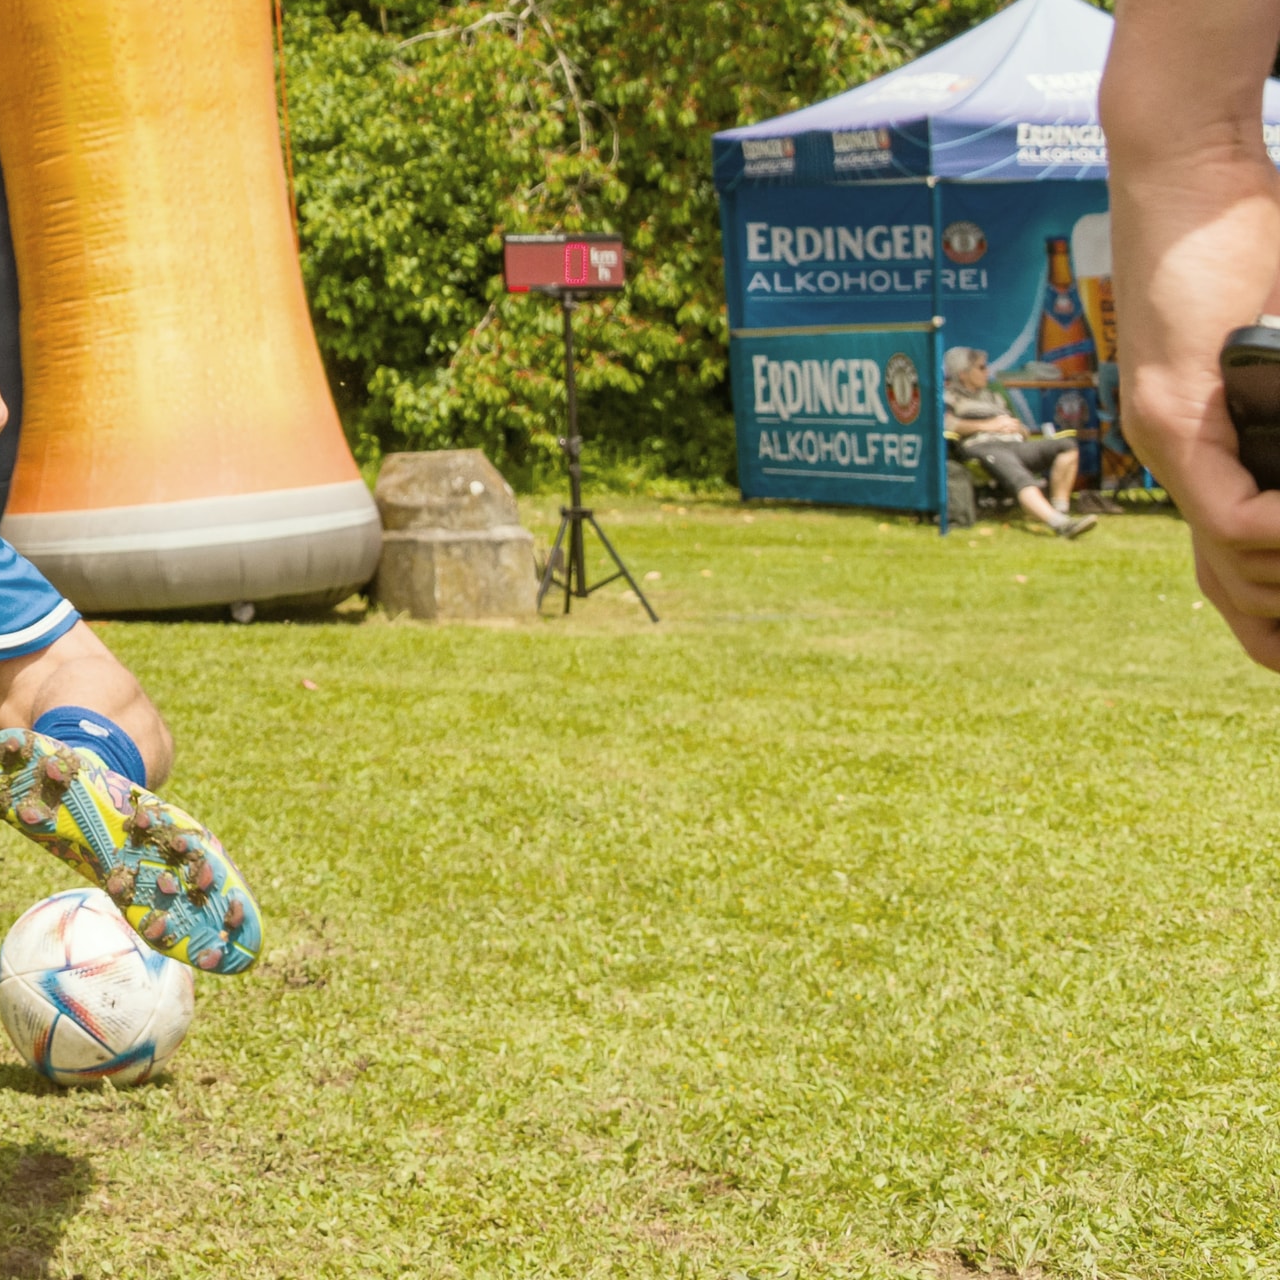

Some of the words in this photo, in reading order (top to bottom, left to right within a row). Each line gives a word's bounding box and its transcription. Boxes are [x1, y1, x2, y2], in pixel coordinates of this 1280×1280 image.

[564, 242, 590, 286] 0
[590, 247, 618, 266] km
[746, 222, 934, 266] ERDINGER
[746, 268, 988, 293] ALKOHOLFREI
[752, 355, 889, 423] ERDINGER
[759, 430, 923, 468] ALKOHOLFREI
